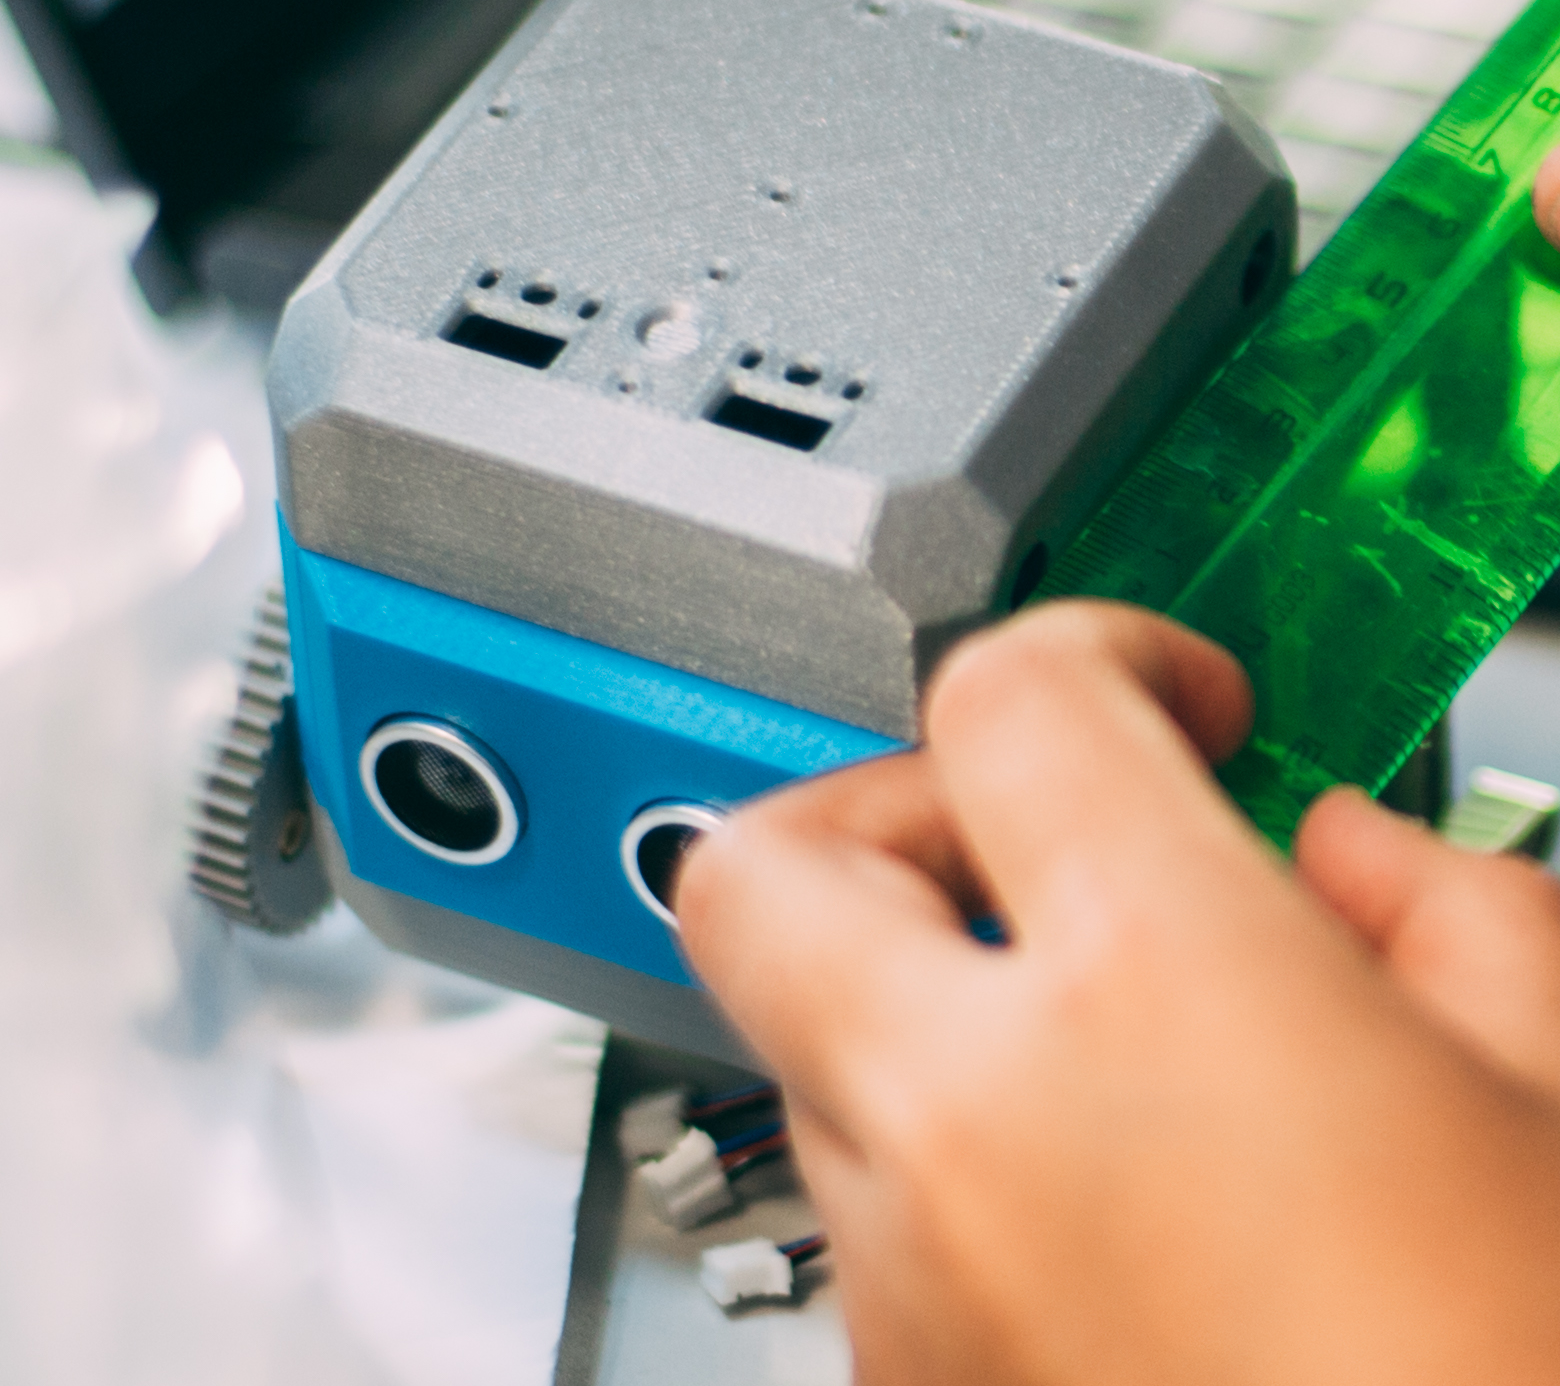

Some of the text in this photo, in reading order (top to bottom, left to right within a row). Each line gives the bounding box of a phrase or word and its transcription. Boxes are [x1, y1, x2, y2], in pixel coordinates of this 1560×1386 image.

[1267, 407, 1300, 441] 3
[1364, 270, 1409, 308] 5
[1476, 148, 1505, 180] 7
